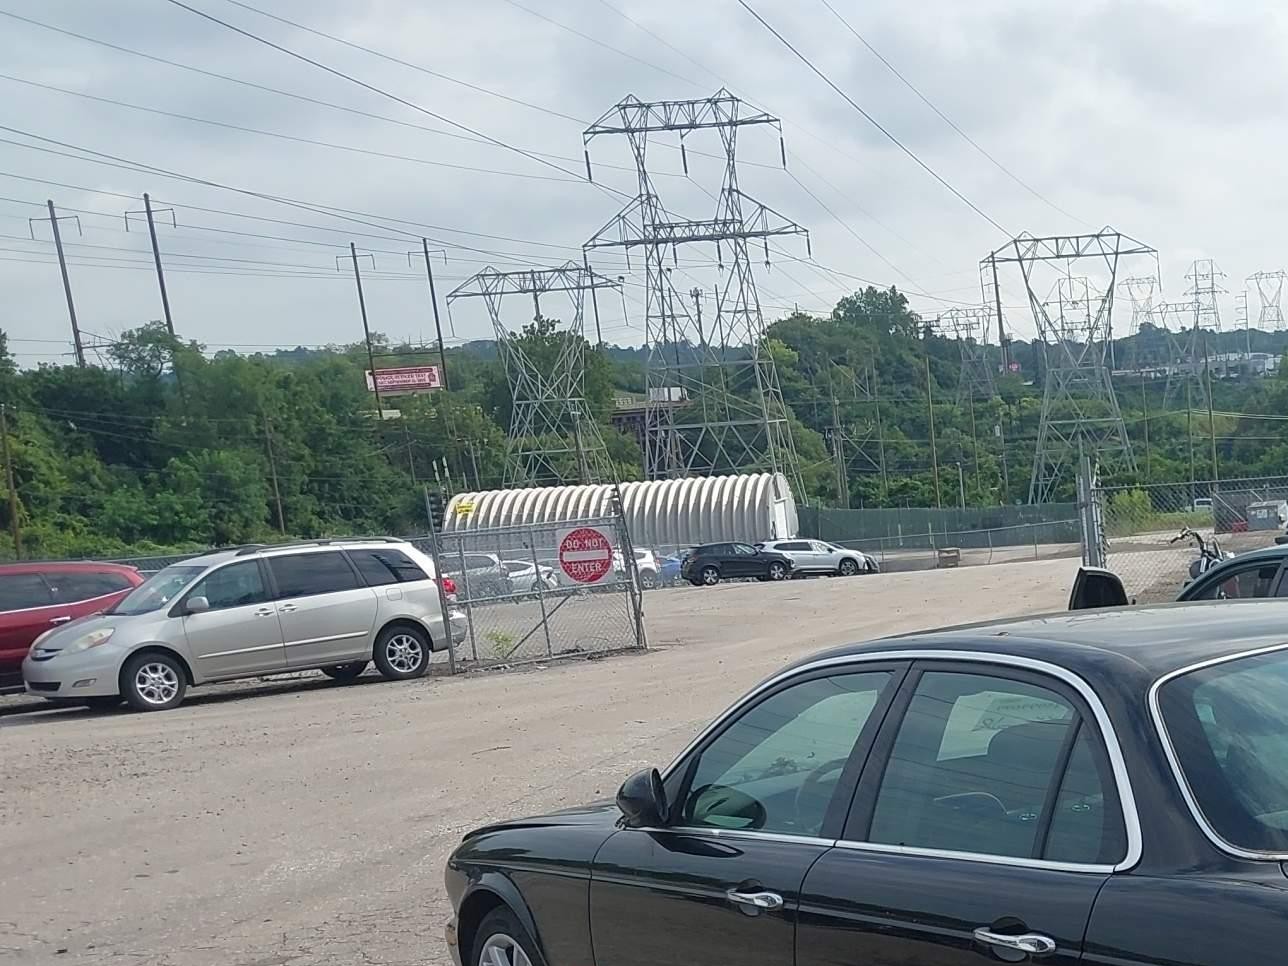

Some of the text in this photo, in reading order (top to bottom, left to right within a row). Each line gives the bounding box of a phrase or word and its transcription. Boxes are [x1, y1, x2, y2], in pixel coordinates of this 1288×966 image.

[566, 539, 603, 549] DO NOT
[571, 562, 602, 573] ENTER
